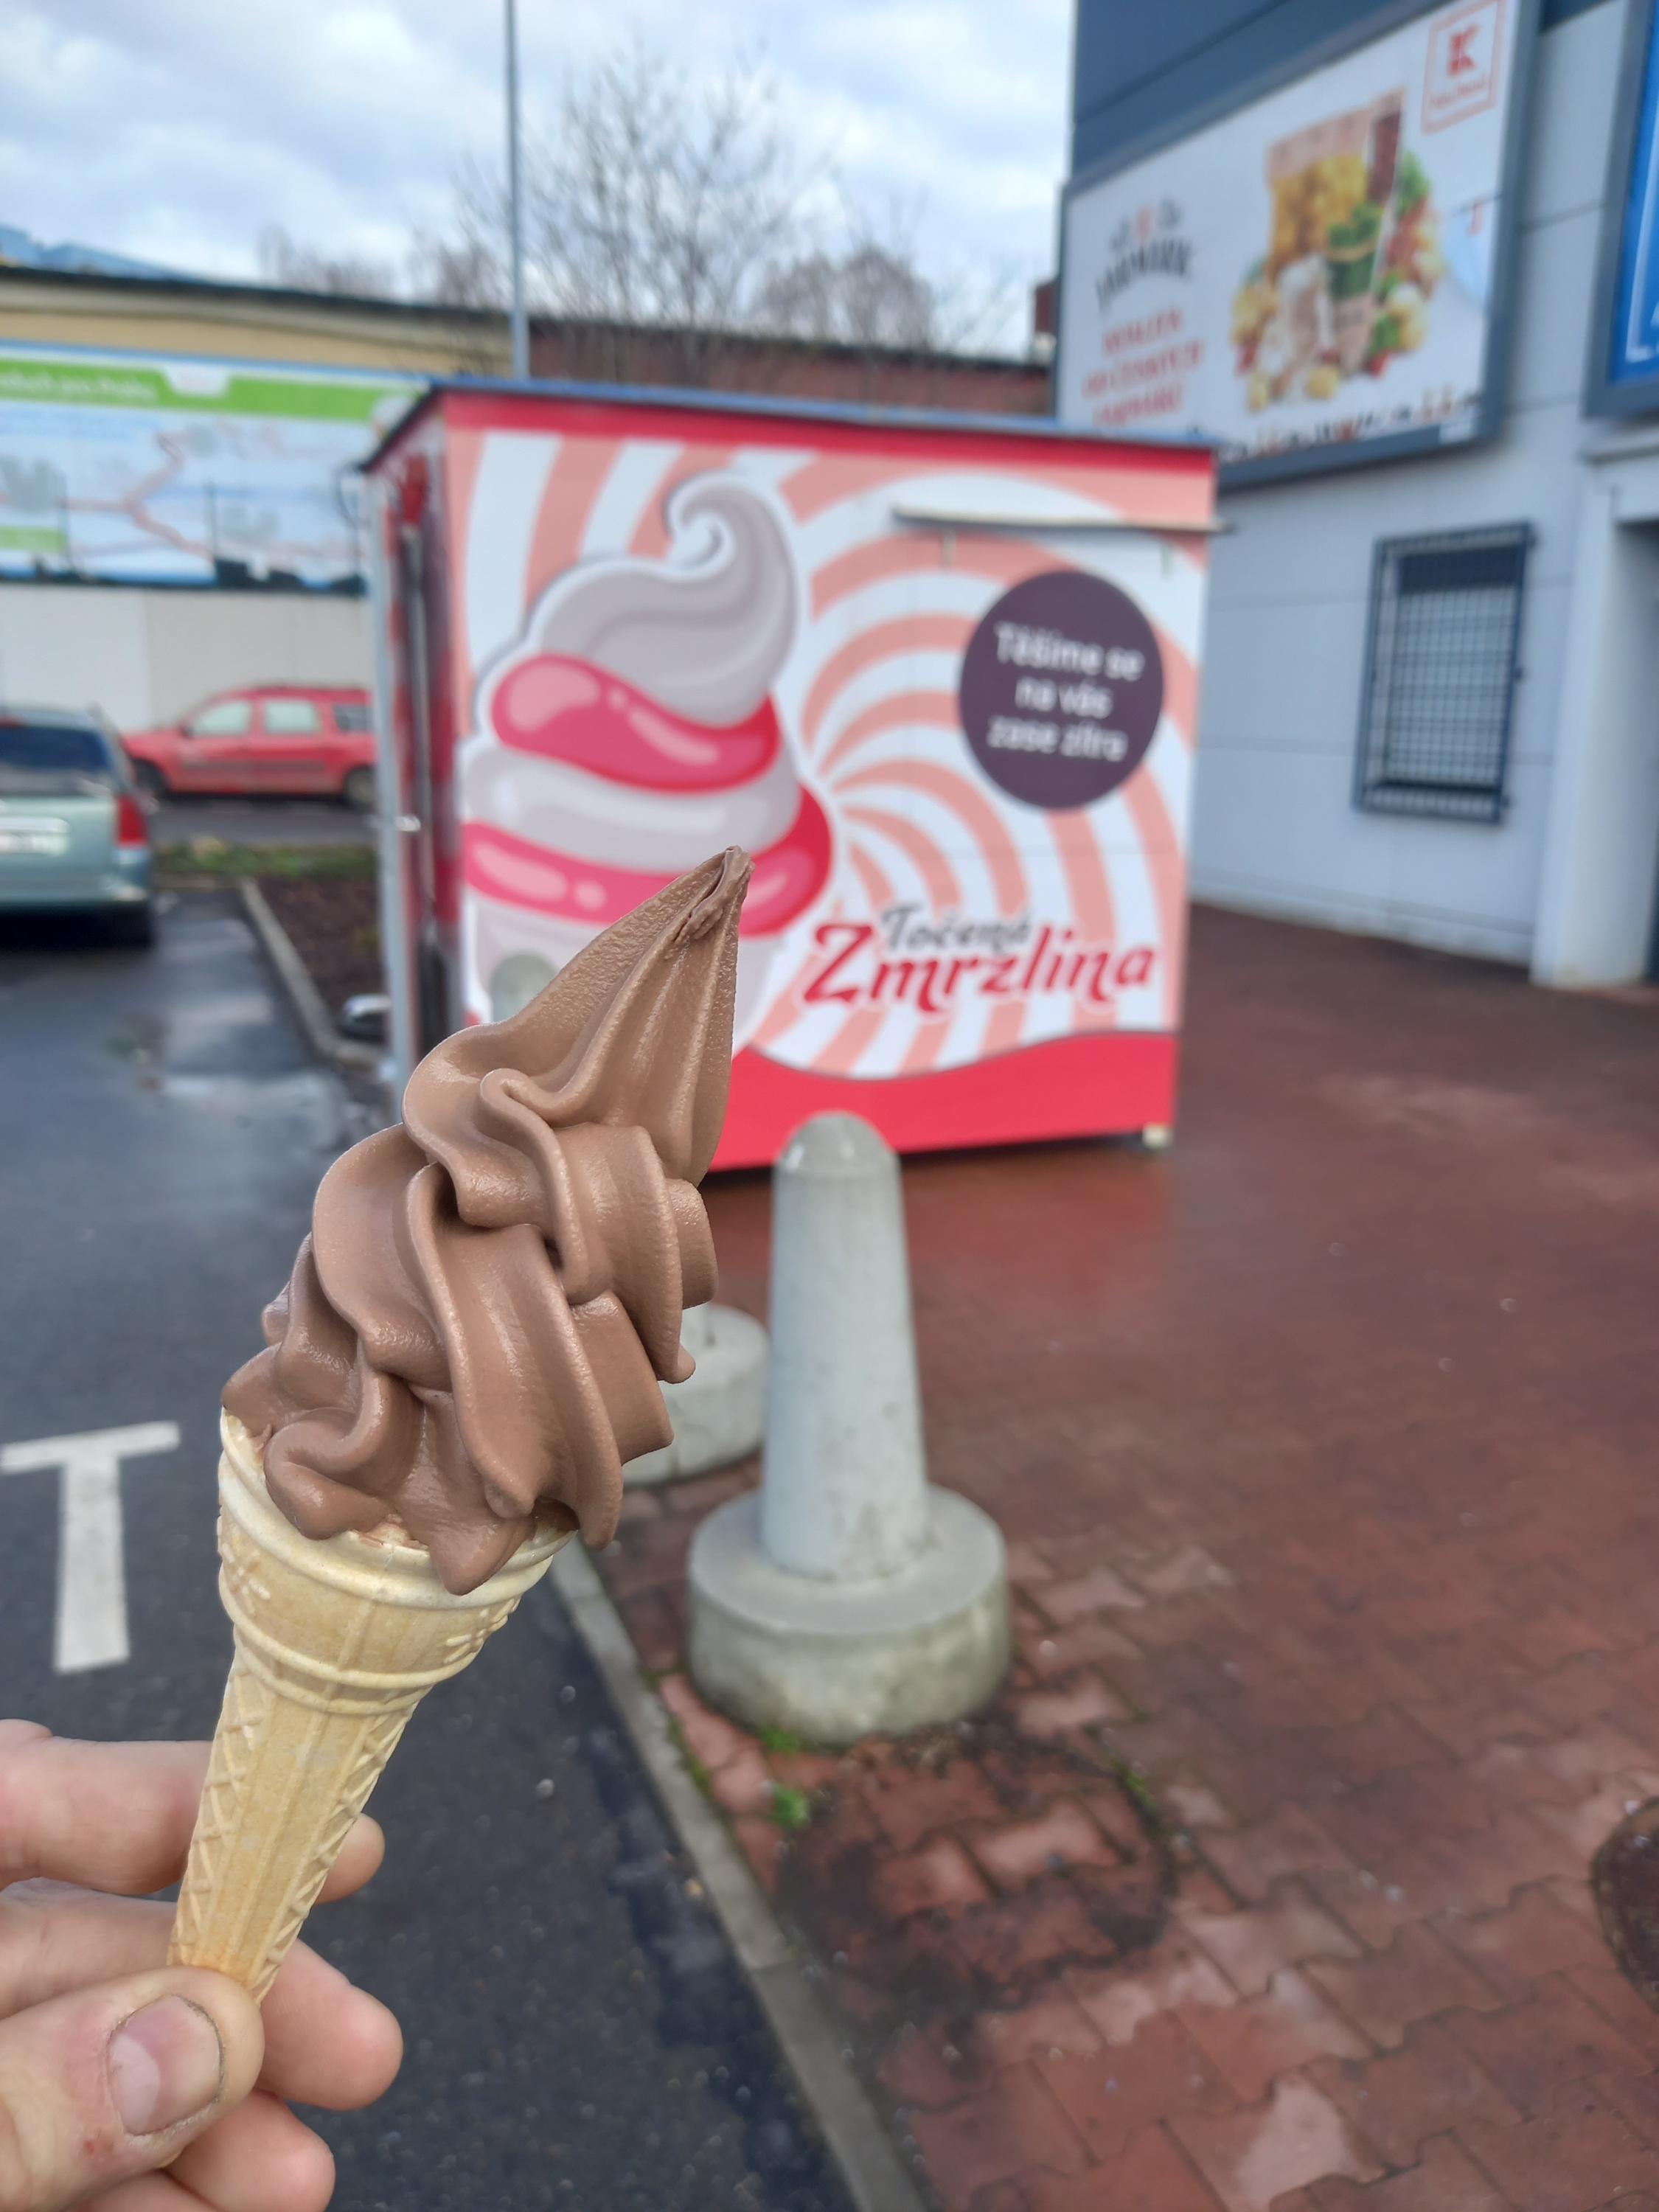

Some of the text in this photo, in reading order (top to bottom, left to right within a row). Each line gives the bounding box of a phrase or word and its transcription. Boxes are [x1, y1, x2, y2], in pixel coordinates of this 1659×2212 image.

[1105, 647, 1145, 682] se
[1015, 677, 1113, 720] na vás
[987, 716, 1058, 754] zase
[804, 925, 1156, 1012] Zmrzlina
